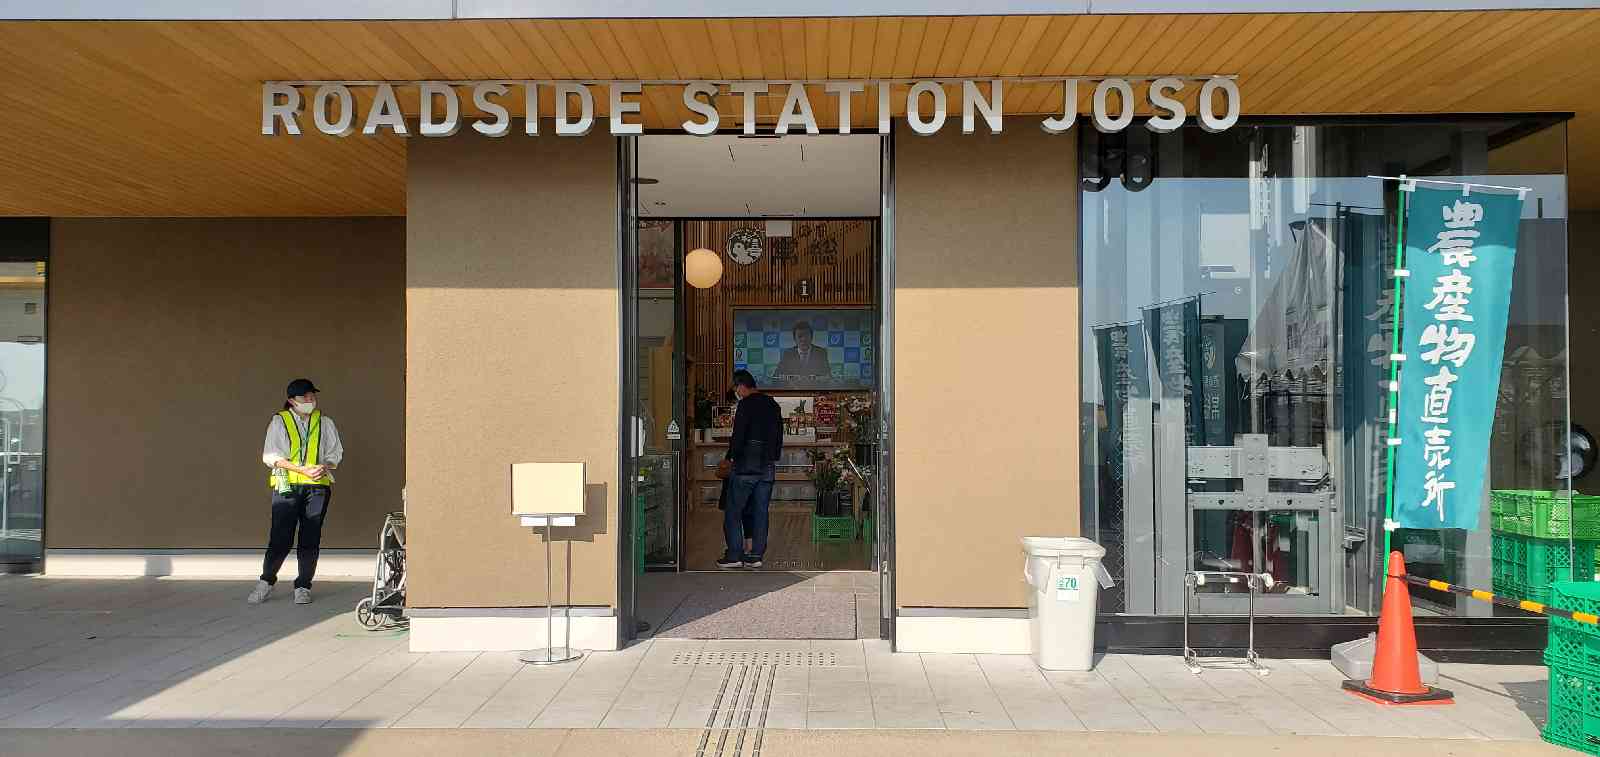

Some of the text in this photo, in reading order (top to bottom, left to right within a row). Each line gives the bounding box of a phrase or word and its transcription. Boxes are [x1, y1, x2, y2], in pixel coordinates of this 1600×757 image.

[261, 77, 1241, 137] ROADSIDE STATION JOSO
[1419, 200, 1484, 522] 農産物直売所
[1065, 577, 1077, 589] 70
